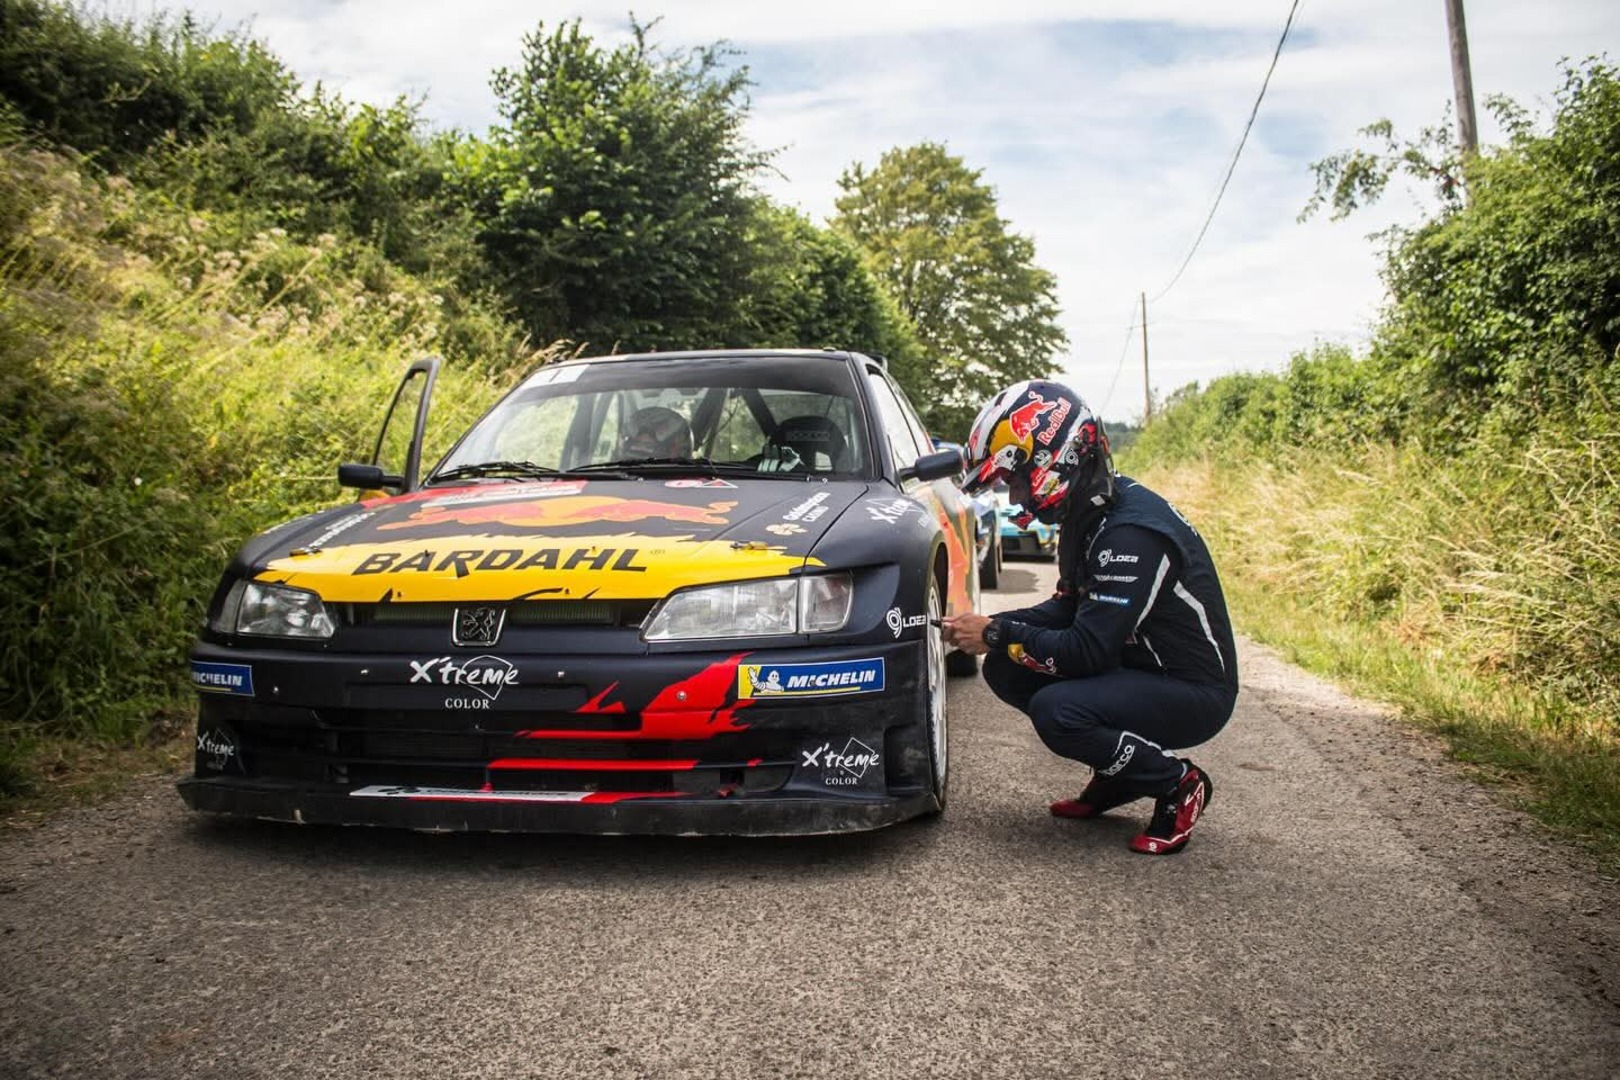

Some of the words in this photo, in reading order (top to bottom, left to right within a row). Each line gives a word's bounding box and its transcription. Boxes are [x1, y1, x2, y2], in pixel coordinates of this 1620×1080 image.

[351, 549, 647, 578] BARDAHL
[787, 670, 876, 688] MICHELIN
[444, 698, 490, 709] COLOR
[825, 777, 857, 785] COLOR
